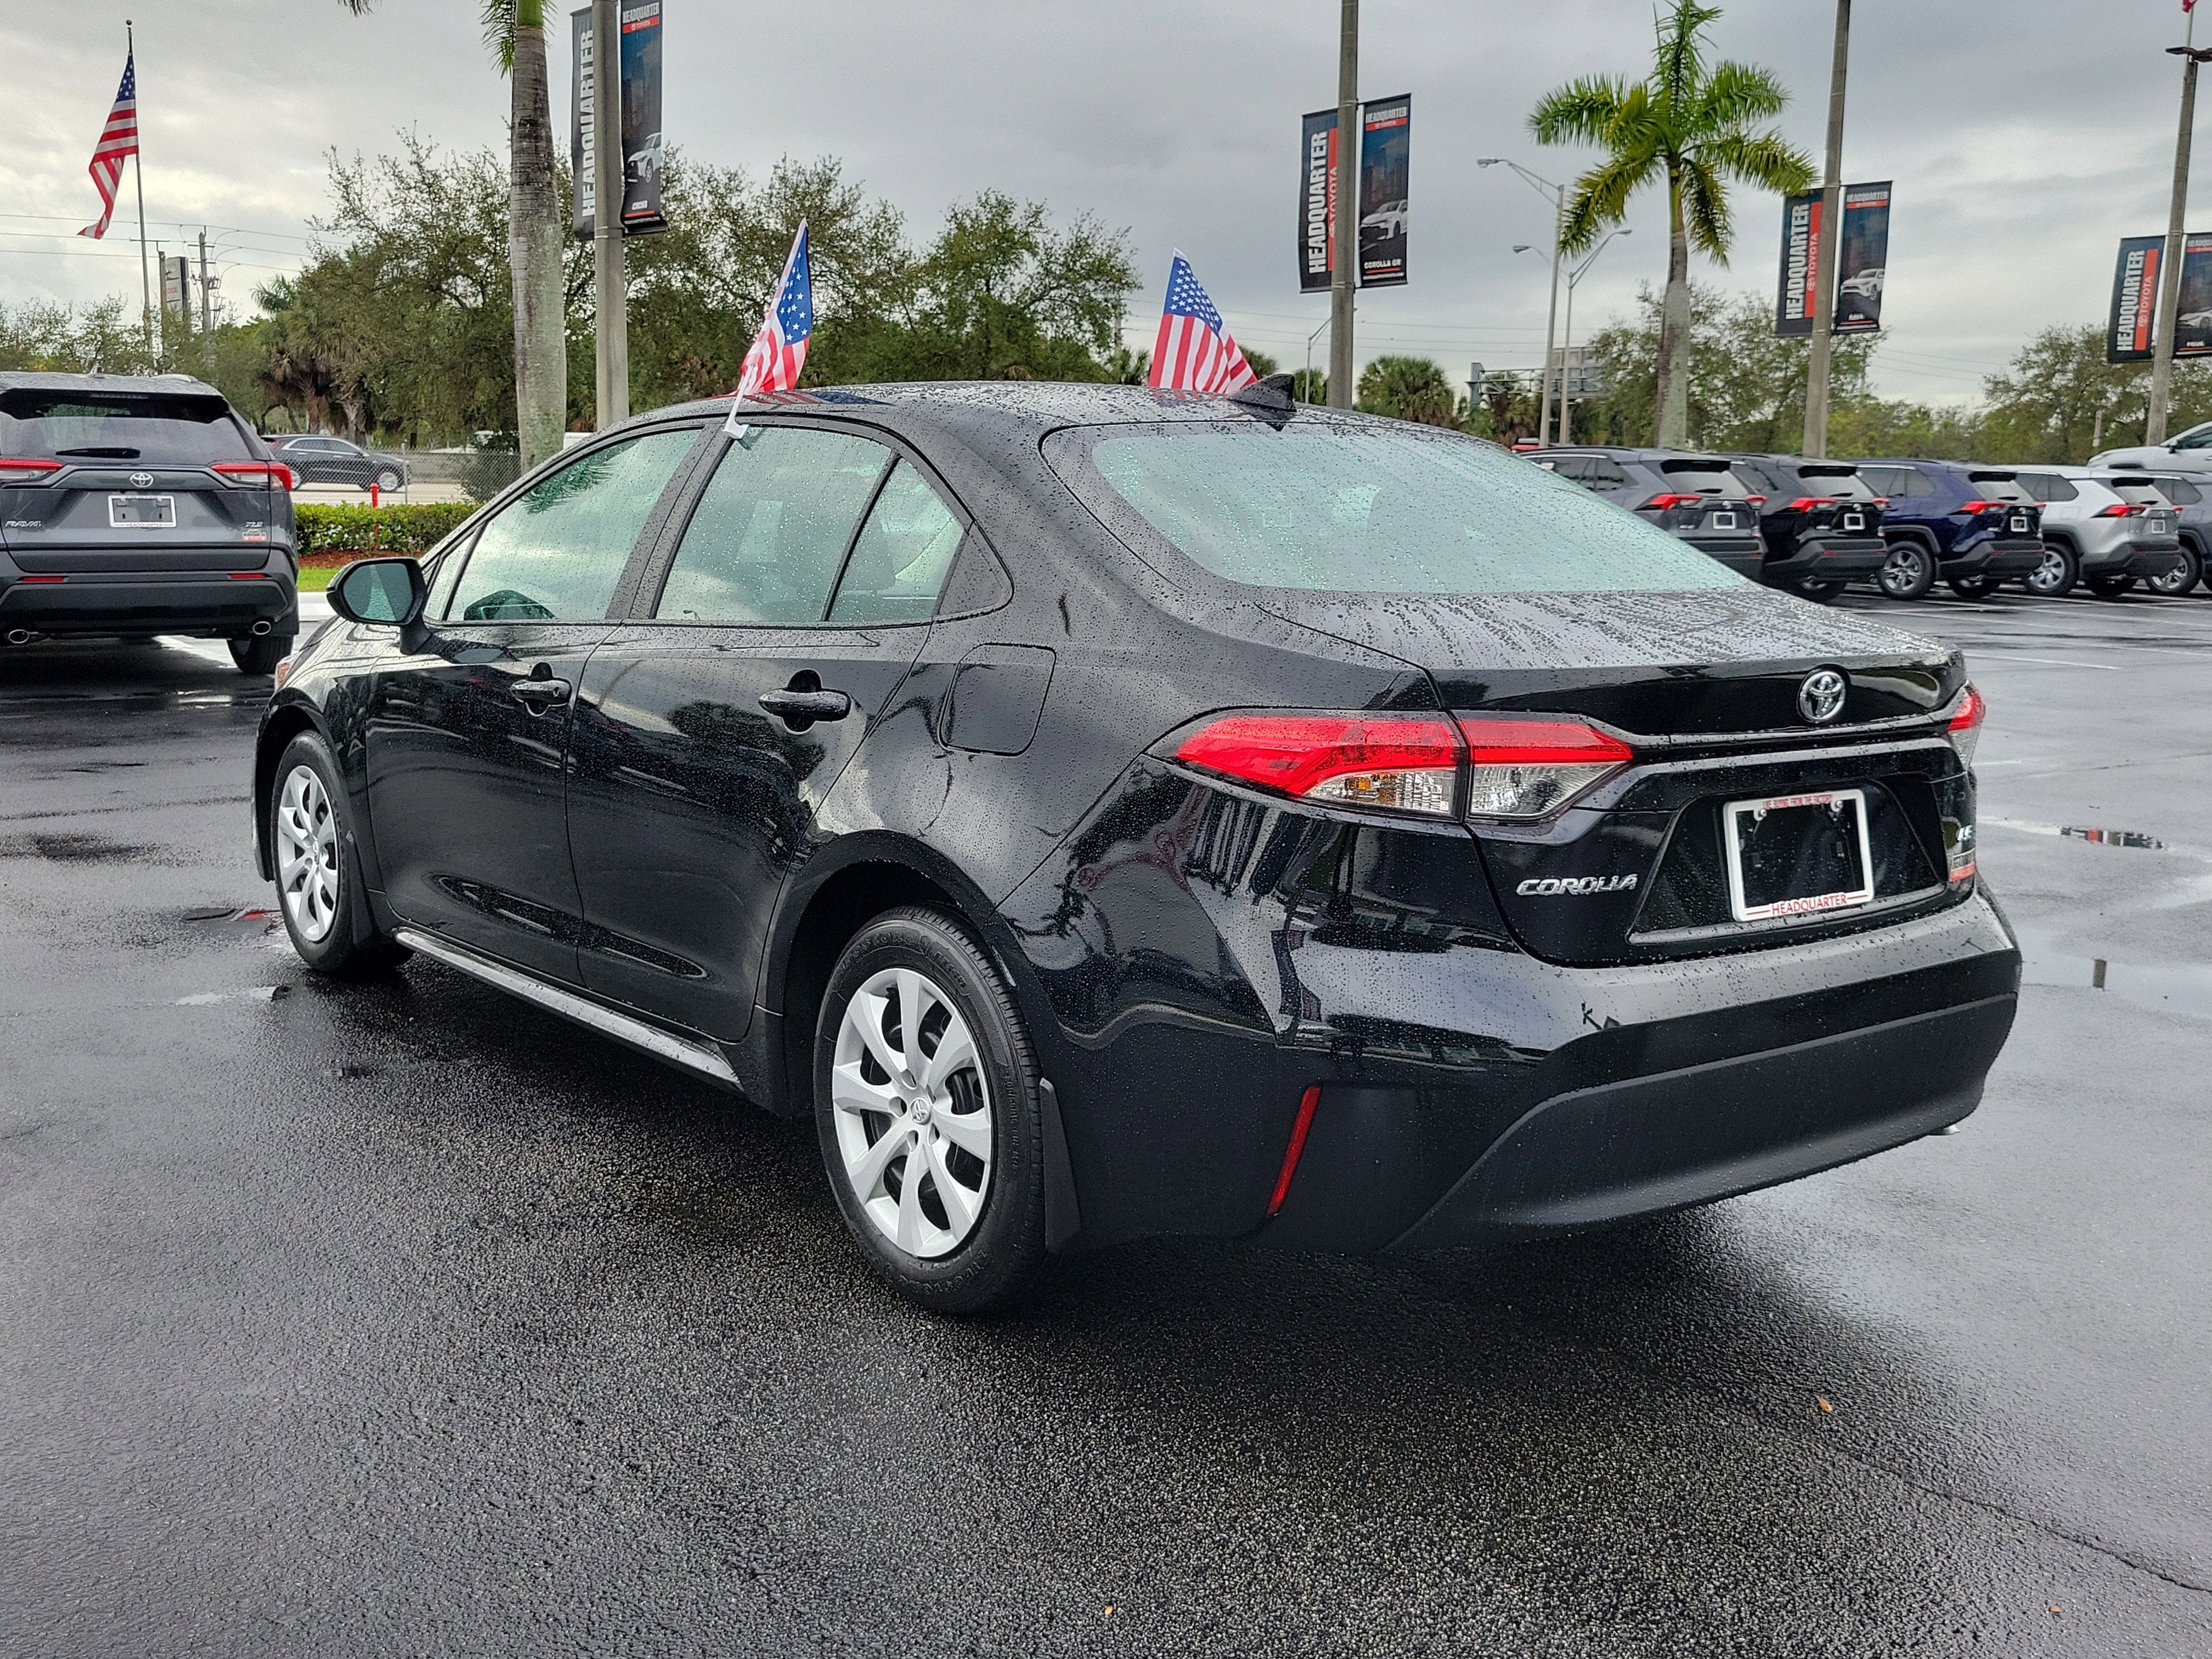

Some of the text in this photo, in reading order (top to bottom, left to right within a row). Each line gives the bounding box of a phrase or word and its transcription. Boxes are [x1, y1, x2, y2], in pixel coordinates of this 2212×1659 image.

[580, 29, 595, 217] HEADQUARTER
[1307, 131, 1327, 274] HEADQUARTER
[1785, 204, 1810, 320] HEADQUARTER
[2117, 250, 2145, 351] HEADQUARTER
[1516, 874, 1638, 895] COROLLA
[1772, 894, 1847, 915] HEADQUARTER
